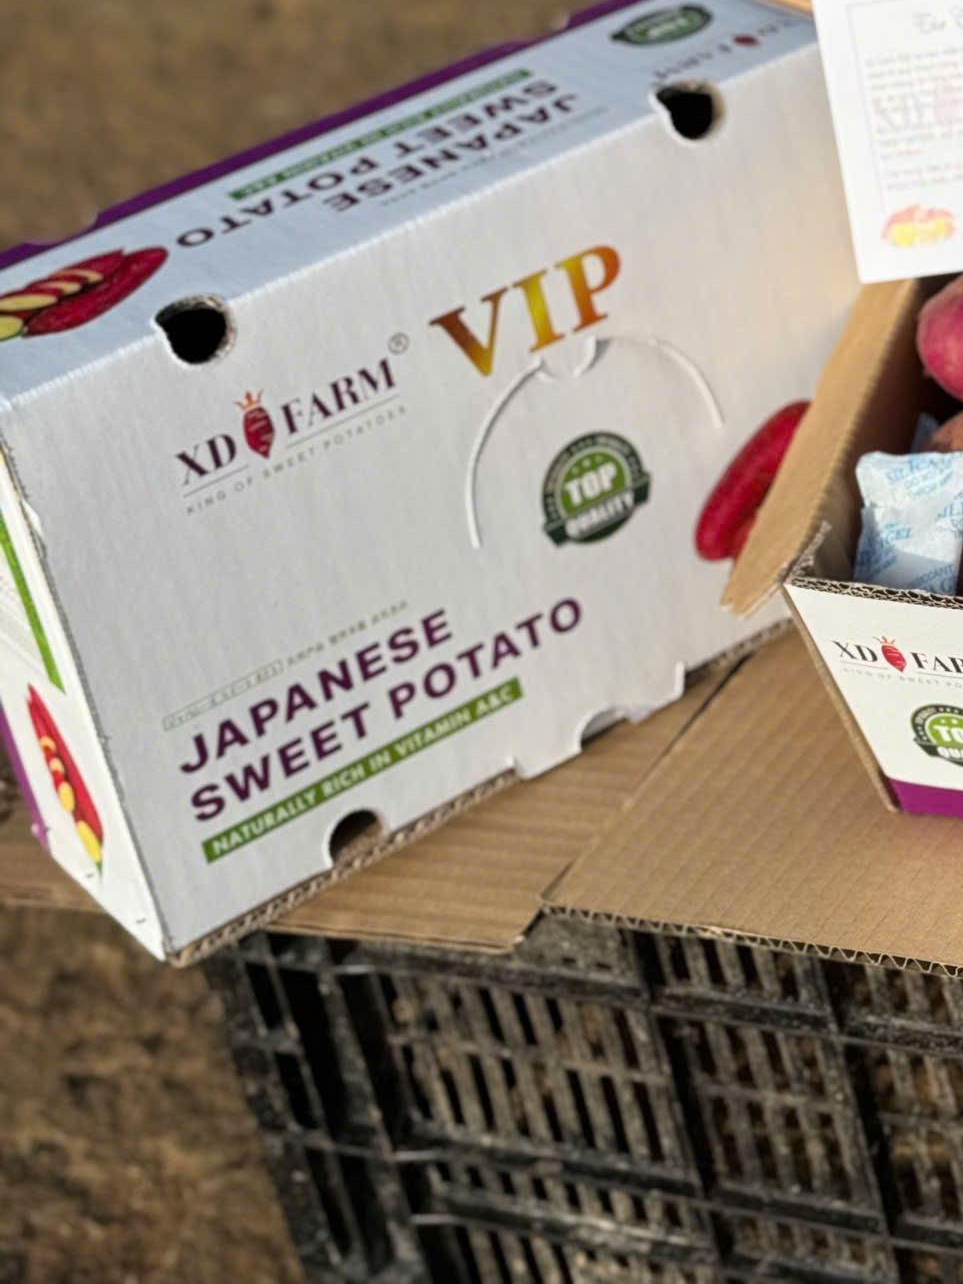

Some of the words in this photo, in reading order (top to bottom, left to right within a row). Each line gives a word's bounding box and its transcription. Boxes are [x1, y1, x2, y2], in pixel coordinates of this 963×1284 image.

[323, 93, 578, 212] JAPANESE
[392, 79, 558, 159] SWEET
[177, 156, 379, 247] POTATO
[429, 244, 621, 378] VIP
[175, 433, 238, 487] XD
[564, 461, 616, 506] TOP
[565, 492, 634, 537] QUALITY
[179, 608, 453, 775] JAPANESE
[832, 640, 878, 664] XD
[191, 703, 370, 821] SWEET
[388, 597, 582, 720] POTATO
[210, 790, 318, 856] NATURALLY
[320, 765, 367, 796] RICH
[369, 753, 392, 772] IN
[398, 710, 471, 757] VITAMIN
[475, 685, 513, 711] A&C
